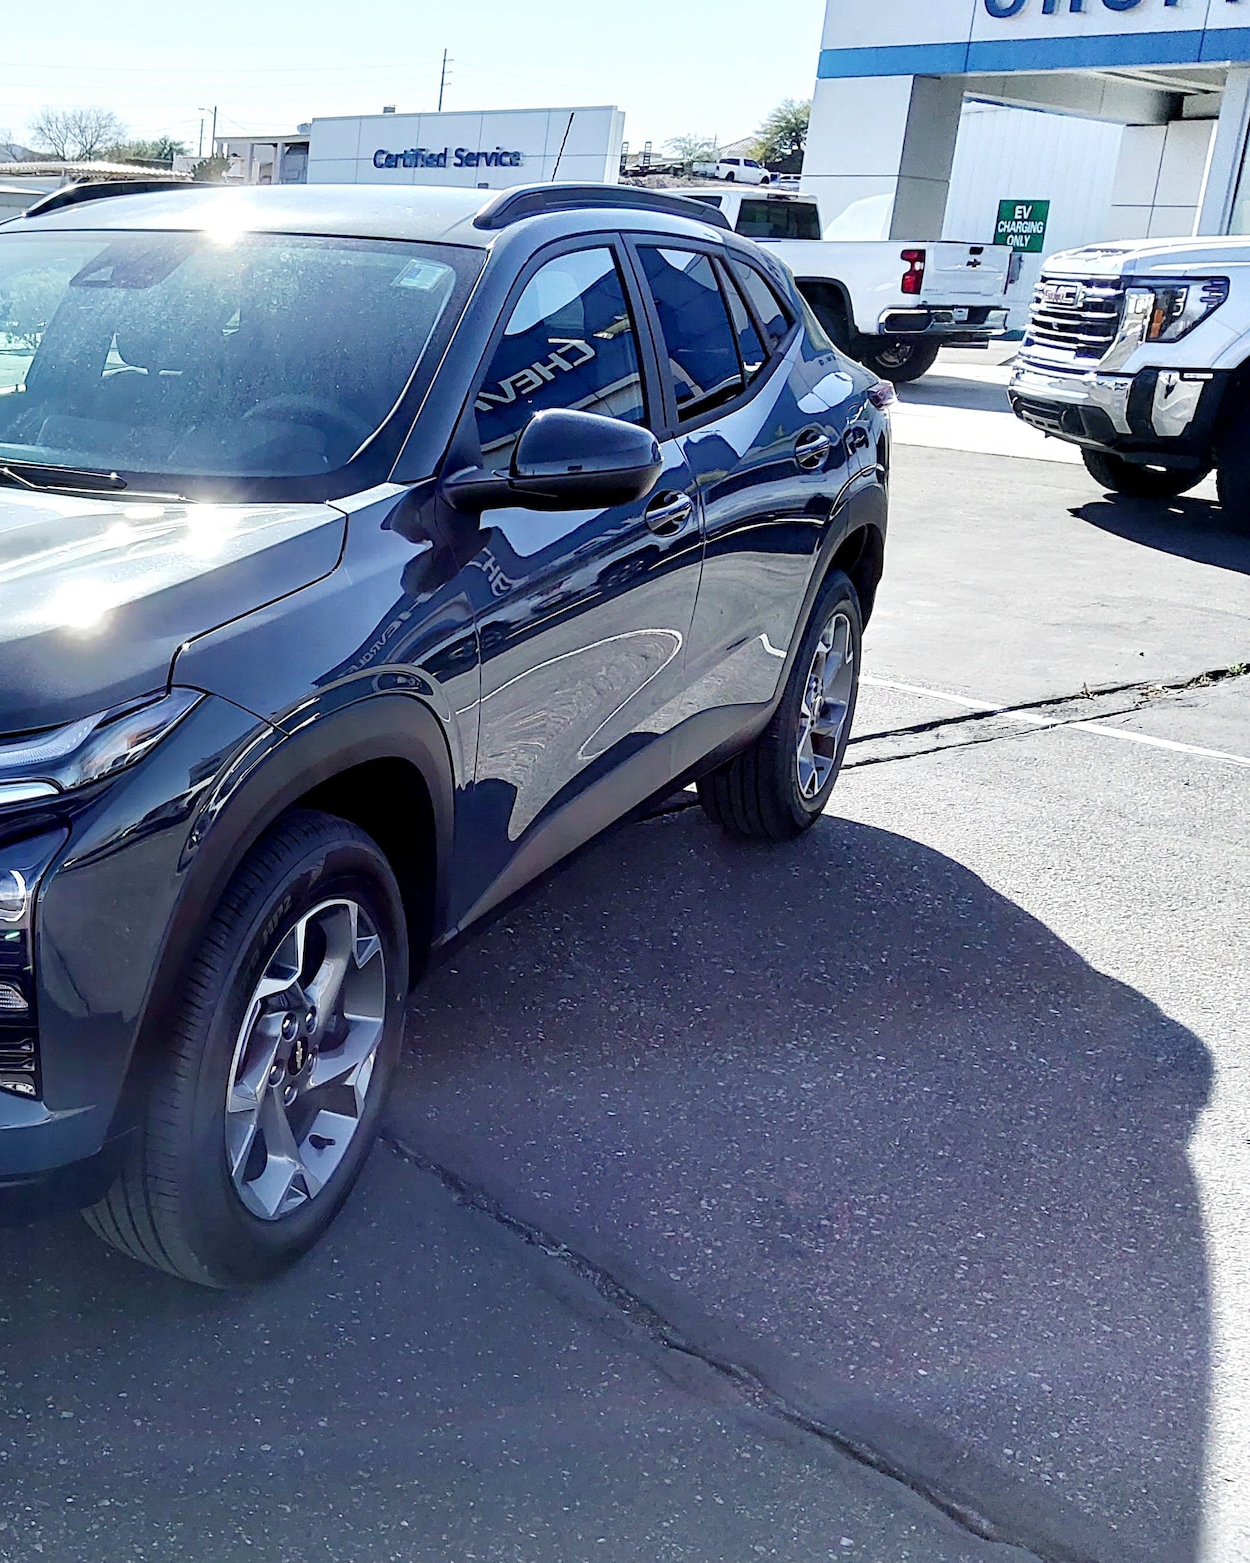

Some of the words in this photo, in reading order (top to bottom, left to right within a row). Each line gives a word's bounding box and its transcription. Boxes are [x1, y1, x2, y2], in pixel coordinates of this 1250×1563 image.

[373, 147, 448, 169] Certified
[453, 146, 523, 168] Service
[1014, 205, 1032, 219] EV
[998, 220, 1044, 234] CHARGING
[1006, 234, 1031, 247] ONLY
